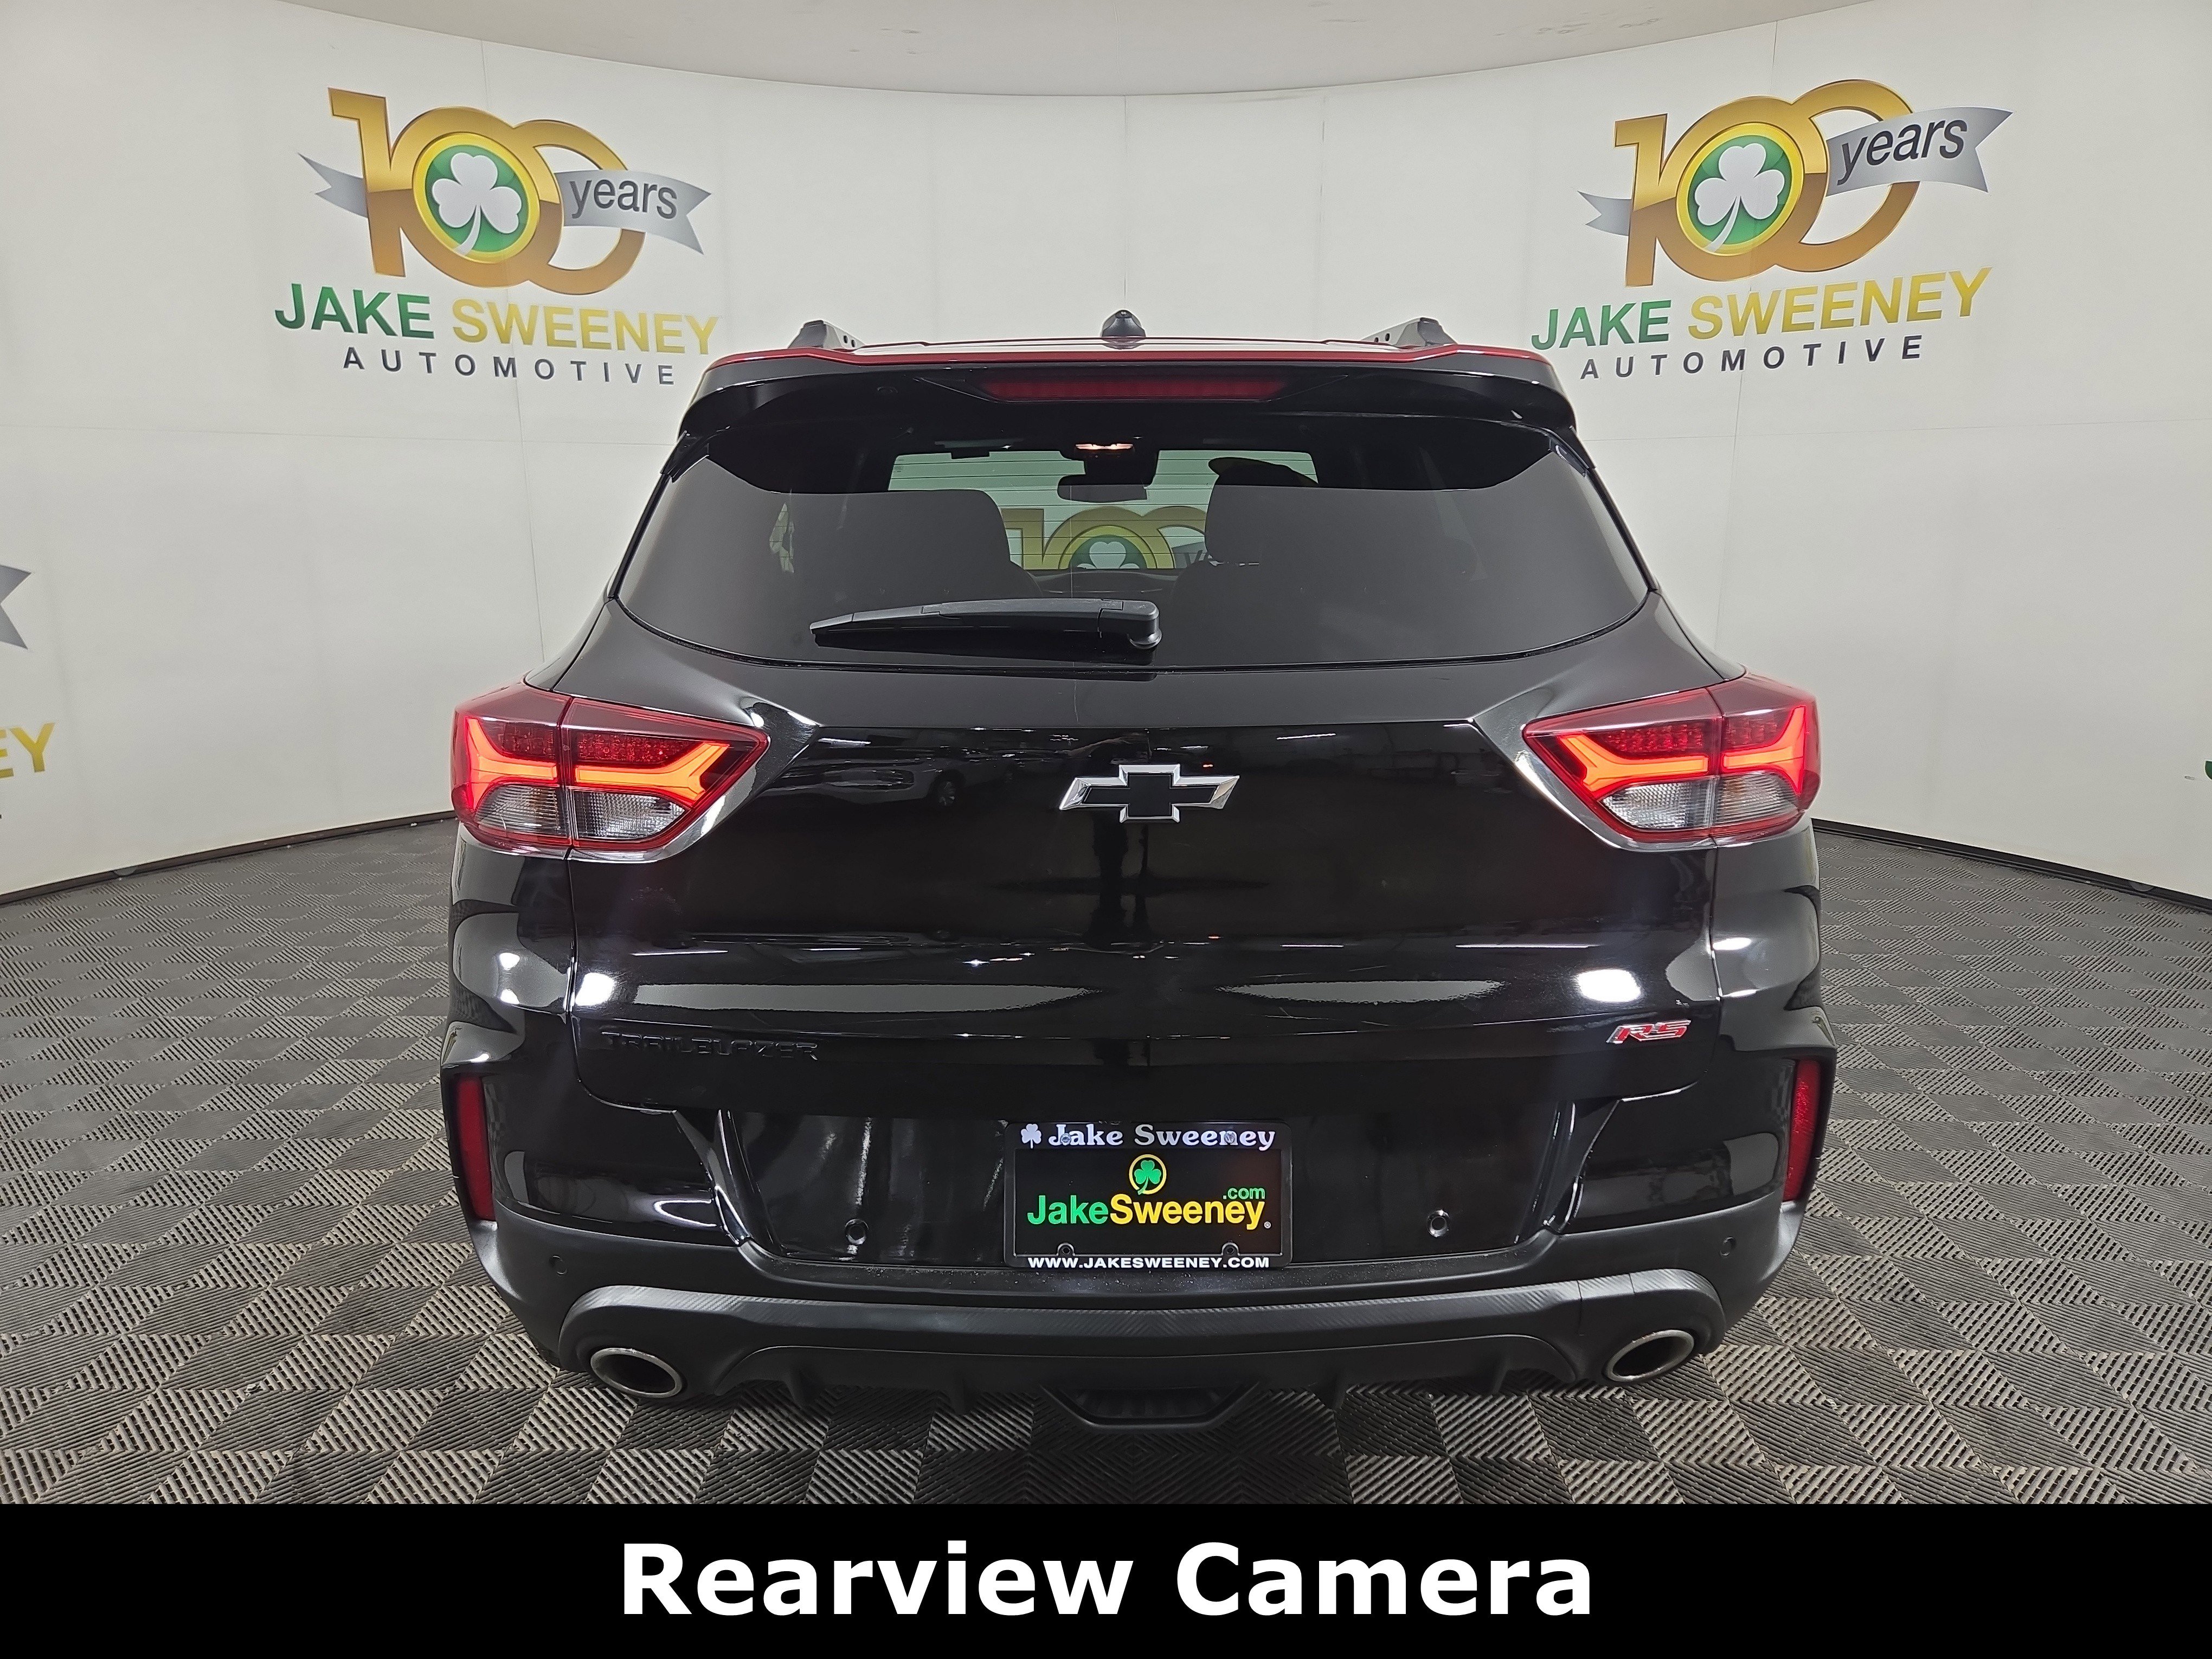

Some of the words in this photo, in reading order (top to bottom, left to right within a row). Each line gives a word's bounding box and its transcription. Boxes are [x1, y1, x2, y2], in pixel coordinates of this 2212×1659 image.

[329, 87, 645, 295] 100
[569, 178, 678, 219] years
[1614, 79, 1920, 286] 100
[1837, 117, 1967, 186] years
[275, 283, 434, 339] JAKE
[452, 299, 722, 356] SWEENEY
[1531, 299, 1672, 350] JAKE
[1687, 267, 1992, 340] SWEENEY
[343, 346, 675, 385] AUTOMOTIVE
[1580, 334, 1922, 380] AUTOMOTIVE
[1606, 1019, 1692, 1044] RS
[1049, 1123, 1124, 1146] Jake
[1135, 1124, 1276, 1151] Sweeney
[1223, 1187, 1265, 1200] .com
[1028, 1257, 1270, 1269] WWW.JAKESWEENEY.COM
